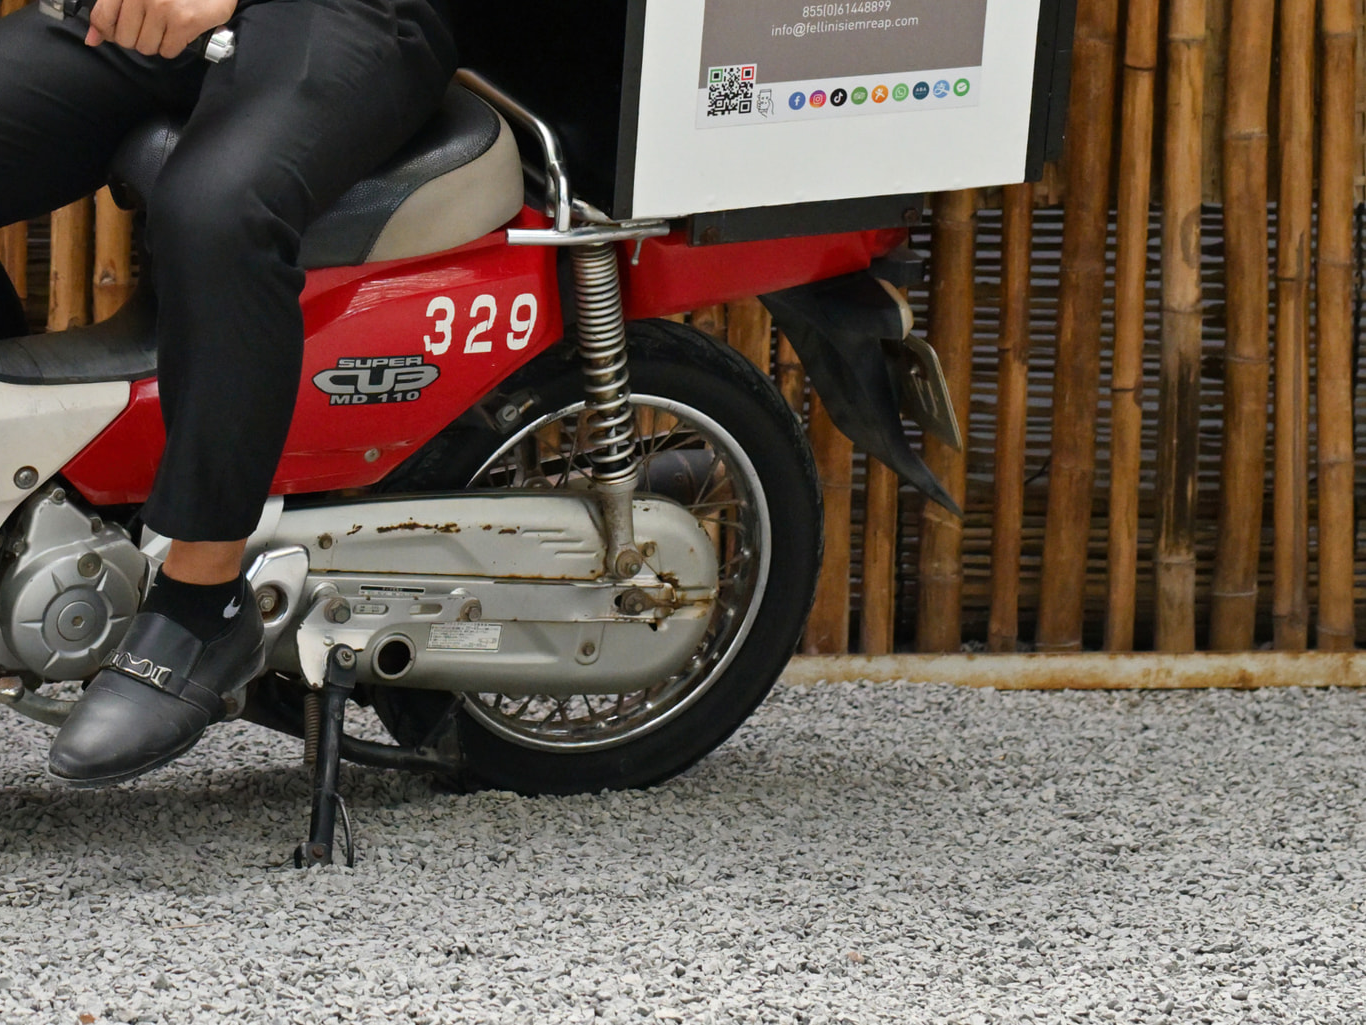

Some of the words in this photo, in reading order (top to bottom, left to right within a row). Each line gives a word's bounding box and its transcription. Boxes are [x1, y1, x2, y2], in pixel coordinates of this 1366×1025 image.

[802, 0, 892, 18] 855(0)61448899
[771, 16, 919, 38] info@fellinisiemreap.com
[423, 293, 538, 356] 329
[337, 356, 422, 368] SUPER
[312, 365, 439, 393] CUB
[329, 394, 368, 405] MD
[380, 391, 420, 403] 110
